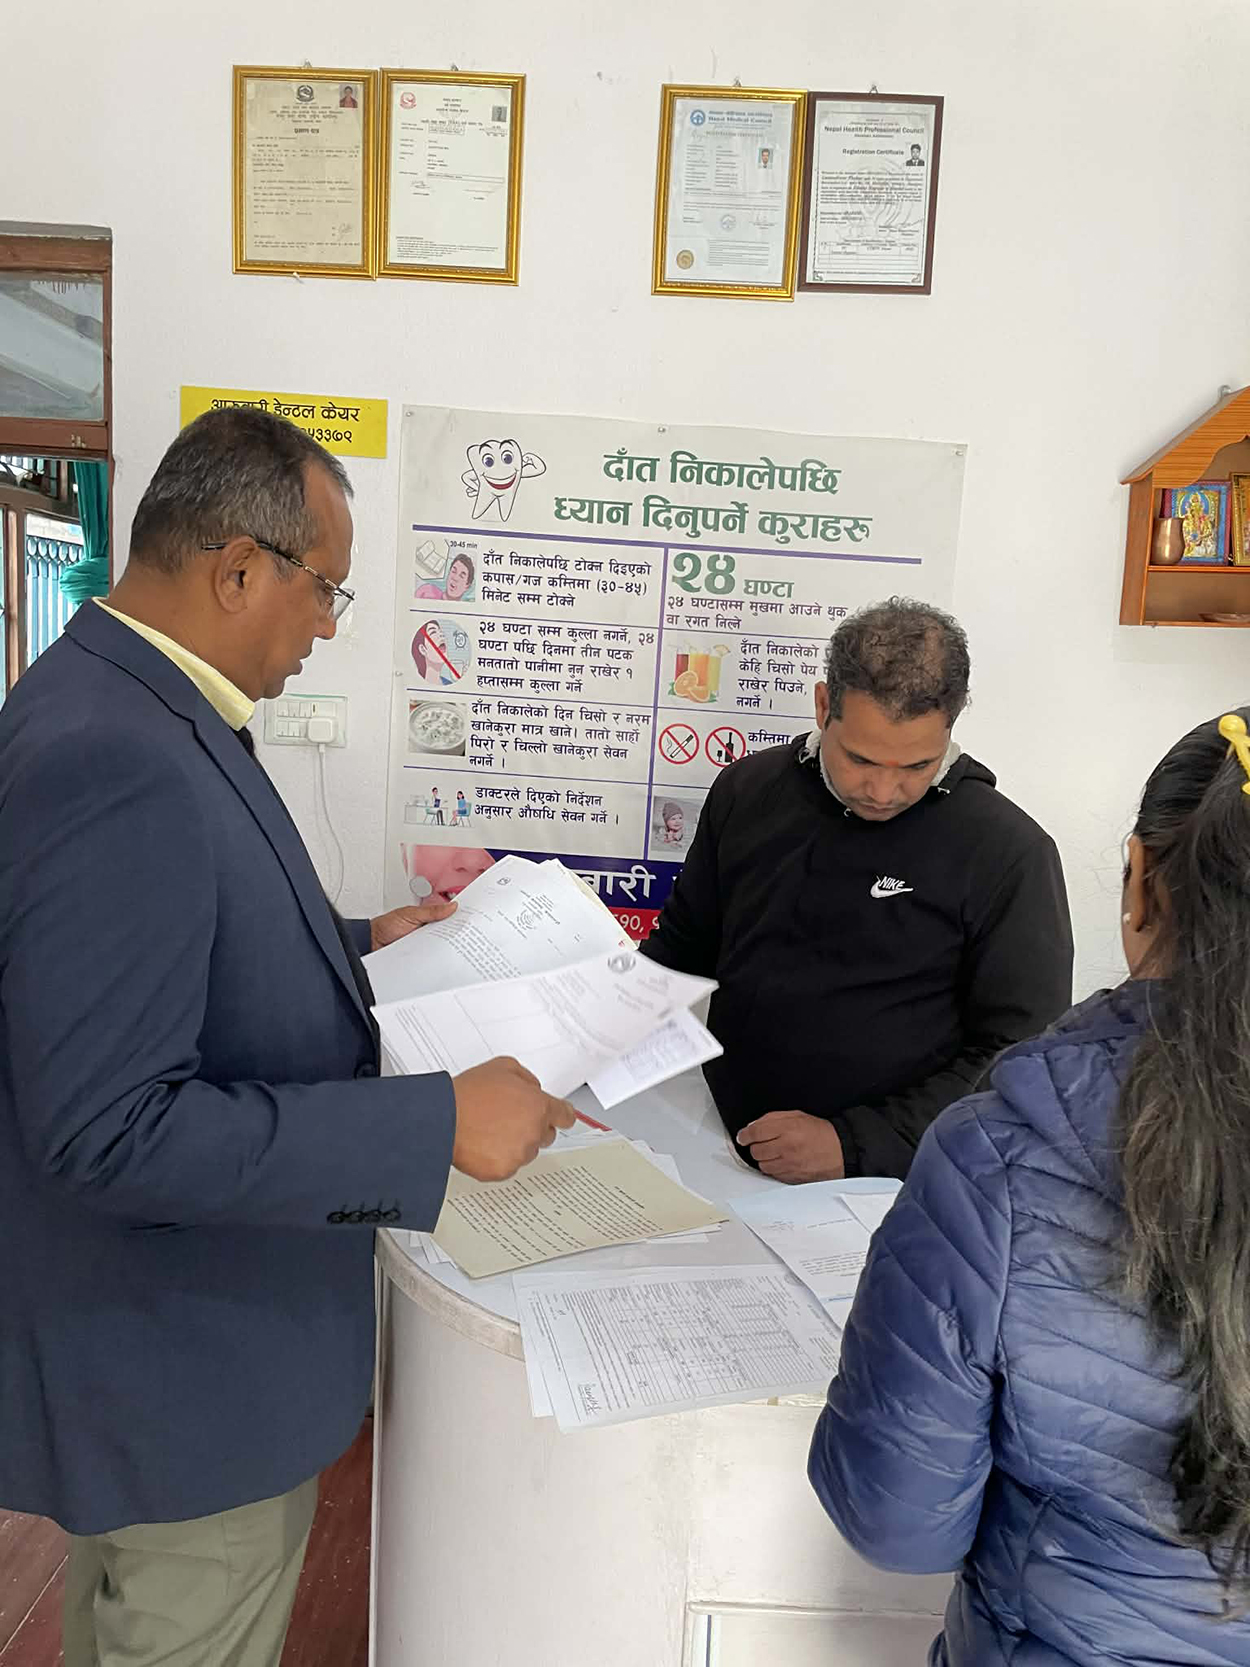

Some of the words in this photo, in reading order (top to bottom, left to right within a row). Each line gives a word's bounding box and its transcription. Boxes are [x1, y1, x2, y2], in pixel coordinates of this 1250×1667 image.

[321, 402, 360, 422] केयर
[603, 447, 660, 482] दाँत
[670, 450, 841, 495] निकालेपछि
[554, 496, 633, 526] ध्यान
[642, 494, 749, 538] दिनुपर्ने
[483, 549, 503, 566] दाँत
[510, 552, 569, 571] निकालेपछि
[609, 560, 651, 577] दिइएको
[482, 571, 541, 587] कपास/गज
[548, 575, 592, 589] कम्तिमा
[672, 552, 736, 595] २४
[744, 579, 794, 598] घण्टा
[481, 589, 511, 602] मिनेट
[517, 594, 540, 605] सम्म
[547, 593, 575, 607] टोक्ने
[668, 596, 684, 608] २४
[691, 597, 745, 612] घण्टासम्म
[750, 601, 784, 616] मुखमा
[789, 602, 822, 616] आउने
[666, 614, 680, 625] वा
[685, 616, 710, 627] रगत
[479, 621, 495, 635] २४
[503, 624, 532, 635] घण्टा
[538, 627, 561, 638] सम्म
[567, 628, 598, 644] कुल्ला
[638, 633, 655, 646] २४
[478, 640, 508, 651] घण्टा
[513, 640, 537, 655] पछि
[543, 641, 575, 657] दिनमा
[581, 645, 602, 658] तीन
[607, 649, 634, 660] पटक
[741, 638, 761, 654] दाँत
[767, 641, 821, 657] निकालेको
[477, 657, 519, 671] मनतातो
[526, 659, 562, 673] पानीमा
[568, 664, 585, 679] नुन
[590, 664, 621, 679] राखेर
[739, 658, 762, 673] केहि
[768, 660, 795, 674] चिसो
[801, 663, 818, 675] पेय
[477, 675, 524, 689] हप्तासम्म
[530, 679, 560, 694] कुल्ला
[738, 678, 769, 693] राखेर
[472, 698, 491, 715] दाँत
[497, 701, 549, 718] निकालेको
[554, 705, 574, 720] दिन
[579, 707, 607, 722] चिसो
[613, 711, 621, 723] र
[626, 714, 651, 726] नरम
[471, 720, 516, 736] खानेकुरा
[521, 725, 543, 736] मात्र
[585, 728, 610, 740] तातो
[470, 736, 495, 751] पिरो
[500, 741, 509, 752] र
[514, 739, 547, 754] चिल्लो
[553, 743, 598, 760] खानेकुरा
[603, 748, 629, 759] सेवन
[475, 785, 521, 802] डाक्टरले
[527, 787, 561, 803] दिएको
[566, 789, 603, 807] निर्देशन
[474, 805, 512, 820] अनुसार
[561, 809, 586, 821] सेवन
[879, 876, 905, 889] NIKE
